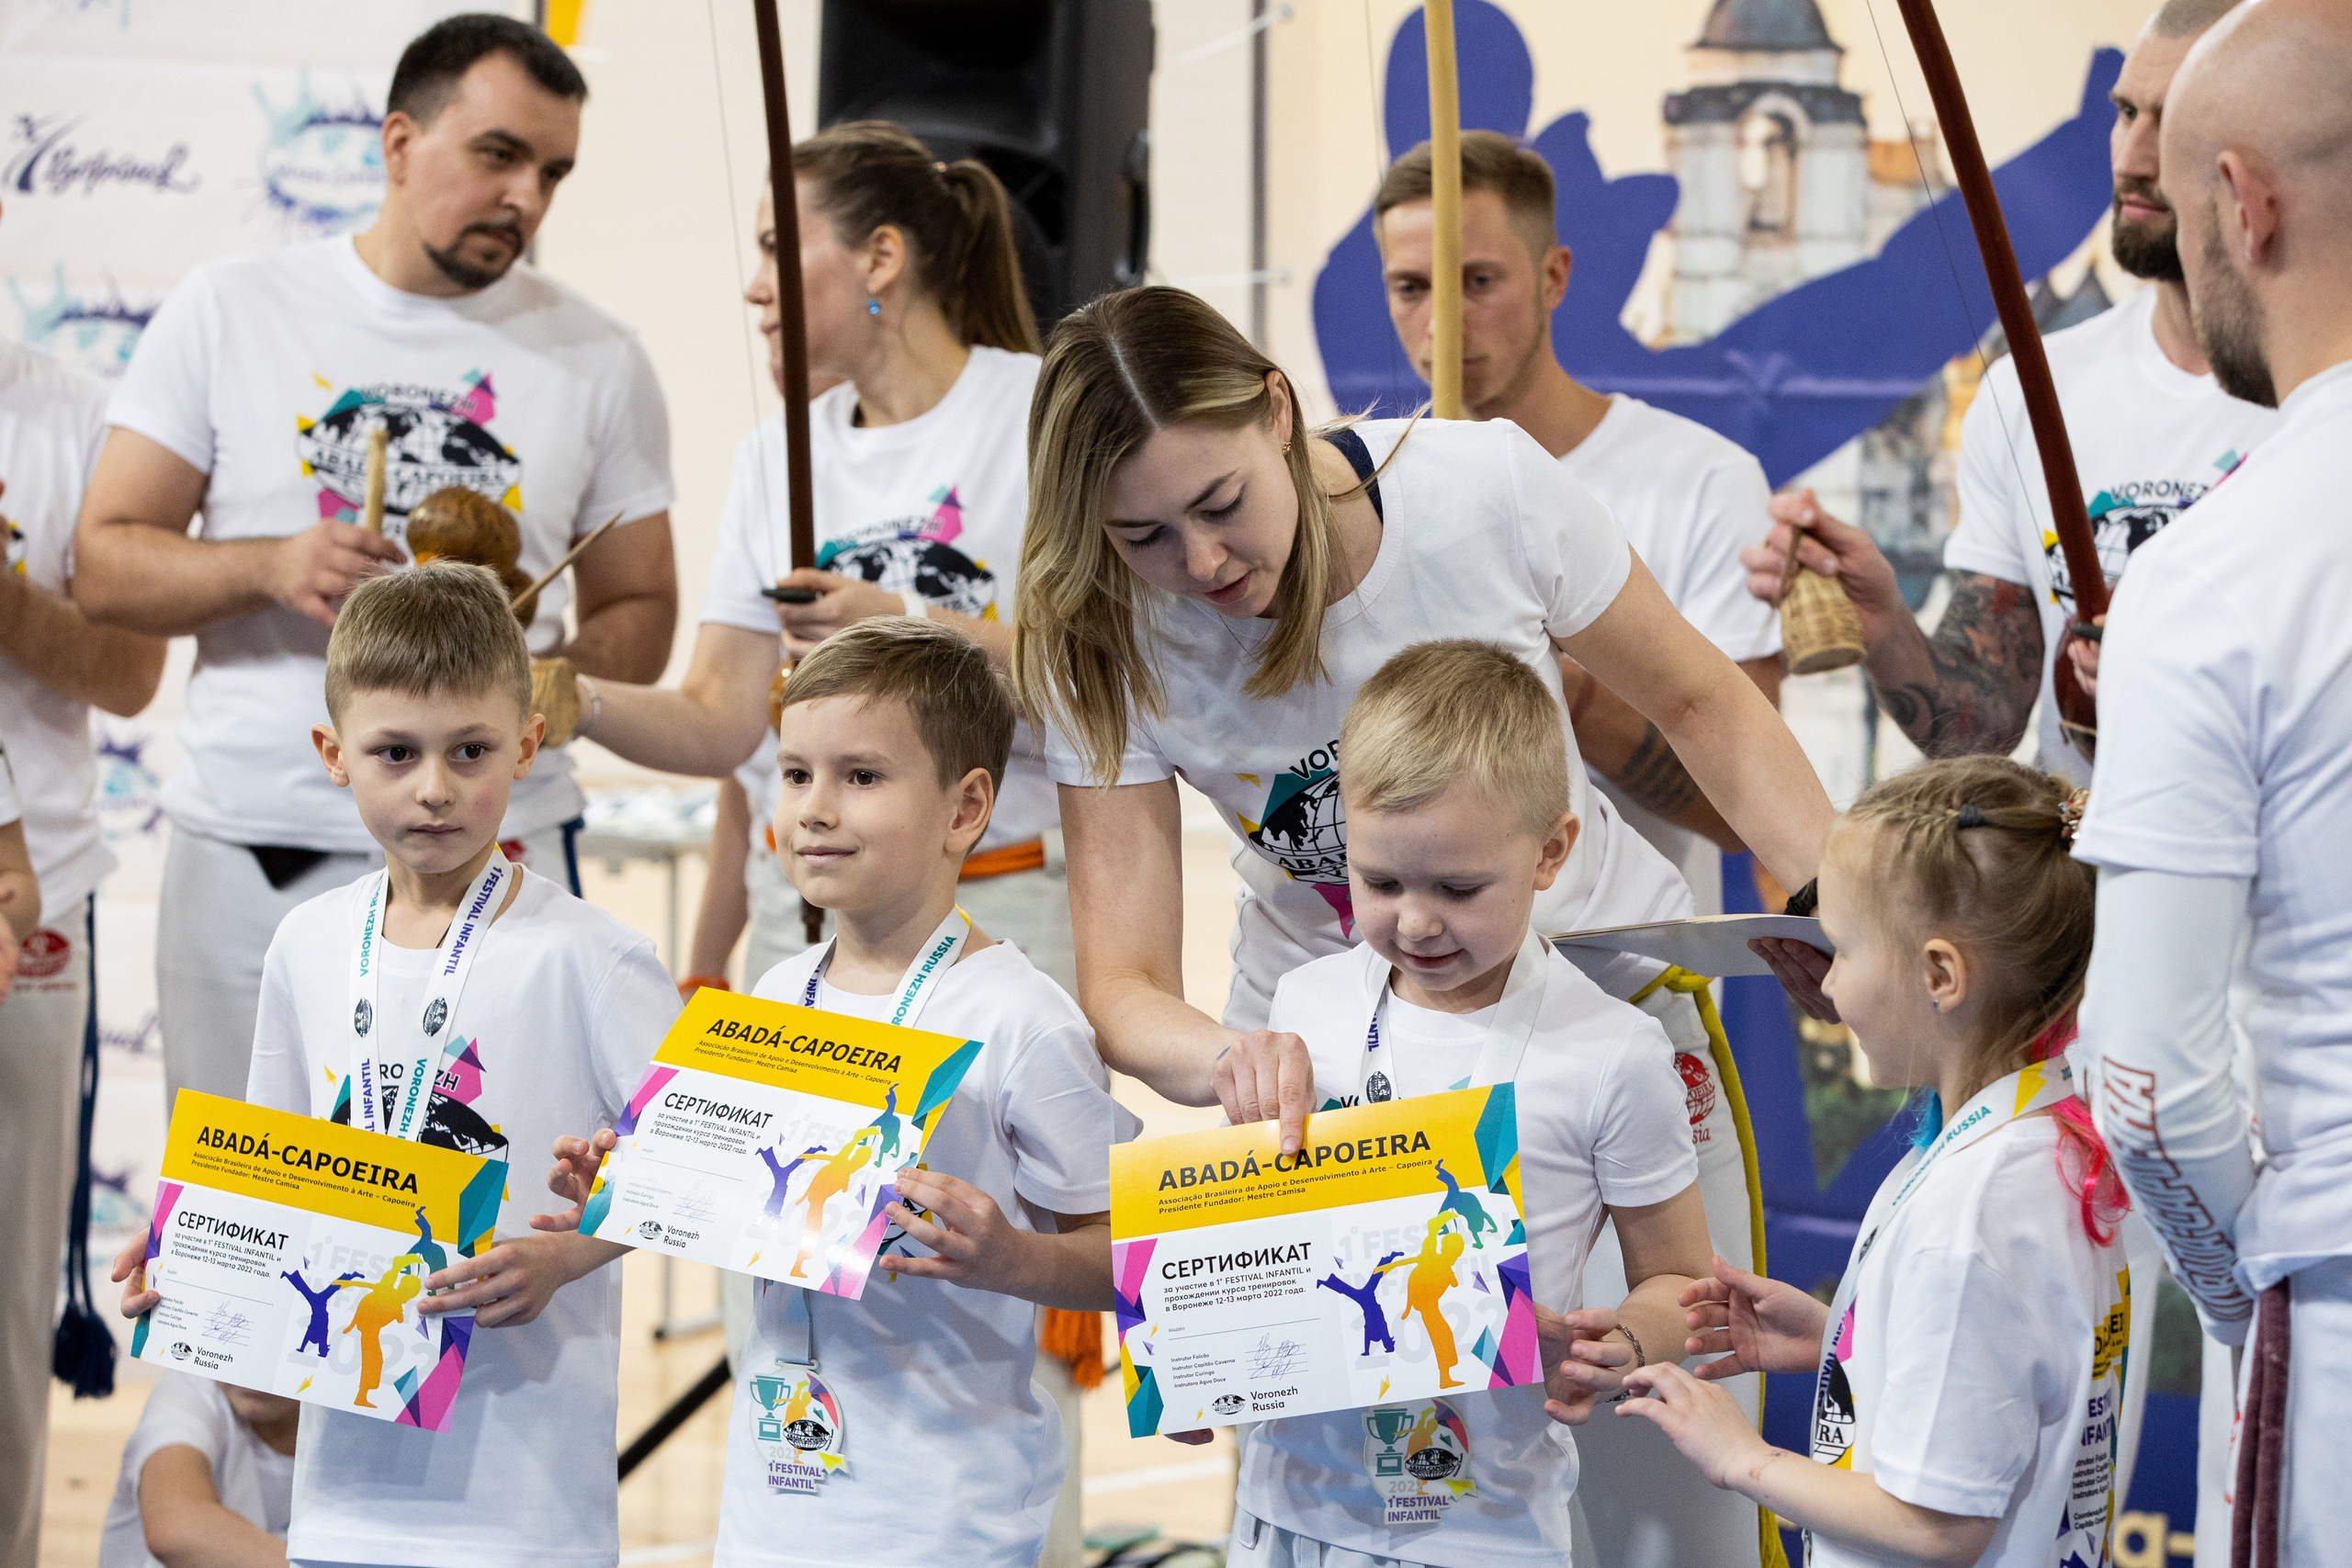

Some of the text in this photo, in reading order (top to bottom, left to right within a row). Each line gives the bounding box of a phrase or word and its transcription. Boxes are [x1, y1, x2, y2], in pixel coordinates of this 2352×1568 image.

[2110, 480, 2211, 500] VORONEZ
[360, 908, 377, 976] VORONEZH
[443, 922, 474, 976] INFANTIL
[891, 935, 957, 1026] RONEZH RUSSIA
[706, 1019, 901, 1073] ABADÁ-CAPOEIRA
[694, 1047, 797, 1073] Presidente Fundador: Mestre Camisa
[730, 1046, 758, 1057] Brasileira
[767, 1055, 785, 1063] Apoio
[790, 1059, 840, 1074] Desenvolvimento
[865, 1075, 891, 1085] Capoeira
[361, 1058, 374, 1119] INFANTIL
[399, 1058, 428, 1133] VORONEZH
[664, 1093, 774, 1128] СЕРТИФИКАТ
[653, 1121, 693, 1133] прохождении
[712, 1134, 745, 1145] тренировок
[665, 1115, 689, 1123] участие
[700, 1121, 727, 1133] FESTIVAL
[728, 1127, 755, 1139] INFANTIL
[1946, 1105, 1992, 1144] RUSSIA
[654, 1128, 684, 1140] Воронеже
[685, 1135, 699, 1144] 12-13
[699, 1140, 718, 1148] марта
[718, 1143, 732, 1151] 2022
[197, 1126, 417, 1194] ABADÁ-CAPOEIRA
[1159, 1131, 1430, 1191] ABADÁ-CAPOEIRA
[191, 1159, 300, 1190] Presidente Fundador: Mestre Camisa
[223, 1158, 252, 1169] Brasileira
[262, 1168, 281, 1177] Apoio
[288, 1173, 349, 1192] Desenvolvimento
[357, 1190, 373, 1198] Arte
[382, 1195, 415, 1208] Capoeira
[1159, 1194, 1203, 1205] Associação
[1204, 1188, 1243, 1198] Brasileira
[1257, 1182, 1280, 1190] Apoio
[1290, 1170, 1359, 1185] Desenvolvimento
[1396, 1159, 1432, 1169] Capoeira
[1159, 1188, 1306, 1214] Presidente Fundador: Mestre Camisa
[178, 1211, 288, 1250] СЕРТИФИКАТ
[663, 1235, 686, 1248] Russia
[668, 1224, 699, 1240] Voronezh
[182, 1235, 202, 1244] участие
[214, 1240, 242, 1253] FESTIVAL
[243, 1247, 275, 1261] INFANTIL
[209, 1250, 227, 1258] курса
[228, 1254, 266, 1268] тренировок
[1162, 1242, 1311, 1280] СЕРТИФИКАТ
[203, 1256, 216, 1265] 12-13
[217, 1260, 236, 1269] марта
[237, 1264, 253, 1273] 2022
[254, 1269, 271, 1278] года.
[1175, 1282, 1207, 1293] участие
[1225, 1272, 1263, 1284] FESTIVAL
[1265, 1267, 1304, 1279] INFANTIL
[1165, 1279, 1296, 1303] прохождении курса тренировок
[1172, 1301, 1214, 1311] Воронеже
[1216, 1295, 1235, 1304] 12-13
[1237, 1293, 1261, 1302] марта
[1263, 1289, 1283, 1298] 2022
[194, 1356, 219, 1370] Russia
[198, 1347, 233, 1362] Voronezh
[1250, 1386, 1298, 1400] Voronezh
[1252, 1400, 1284, 1412] Russia
[768, 1475, 815, 1490] INFANTIL
[775, 1462, 822, 1477] FESTIVAL
[1396, 1495, 1450, 1508] FESTIVAL
[1387, 1509, 1442, 1522] INFANTIL
